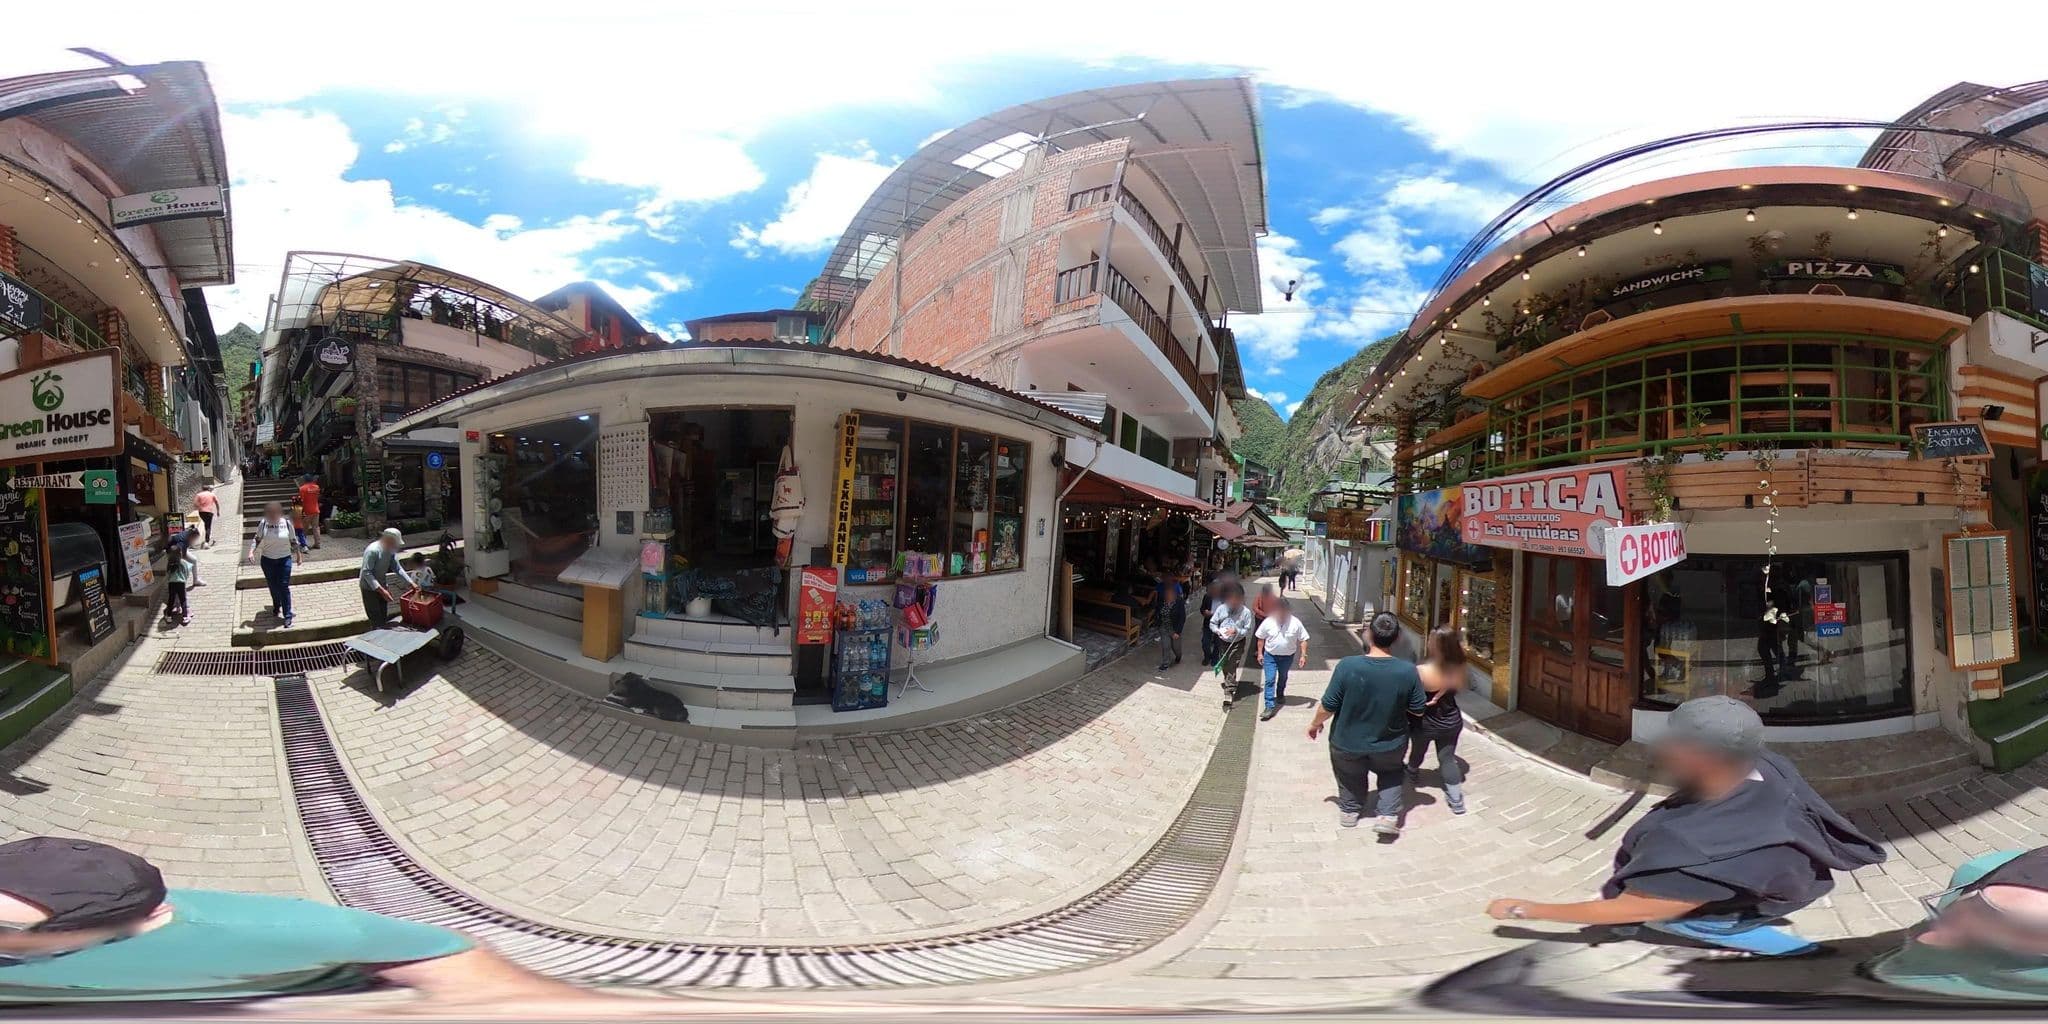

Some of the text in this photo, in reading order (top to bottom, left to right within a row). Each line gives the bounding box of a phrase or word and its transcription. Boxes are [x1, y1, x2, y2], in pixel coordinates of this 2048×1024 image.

[117, 200, 218, 218] Green House
[1788, 262, 1873, 277] PIZZA
[1612, 267, 1704, 297] SANDWICH'S
[46, 408, 111, 432] House
[15, 434, 89, 450] ORGANIC CONCEPT
[14, 474, 72, 488] RESTAURANT
[836, 415, 857, 564] MONEY EXCHANGE
[1463, 470, 1624, 522] BOTICA
[1494, 513, 1561, 522] MULTISERVICIOS
[1484, 521, 1580, 542] Las Orquideas
[1641, 529, 1685, 569] BOTICA
[1822, 627, 1841, 635] VISA
